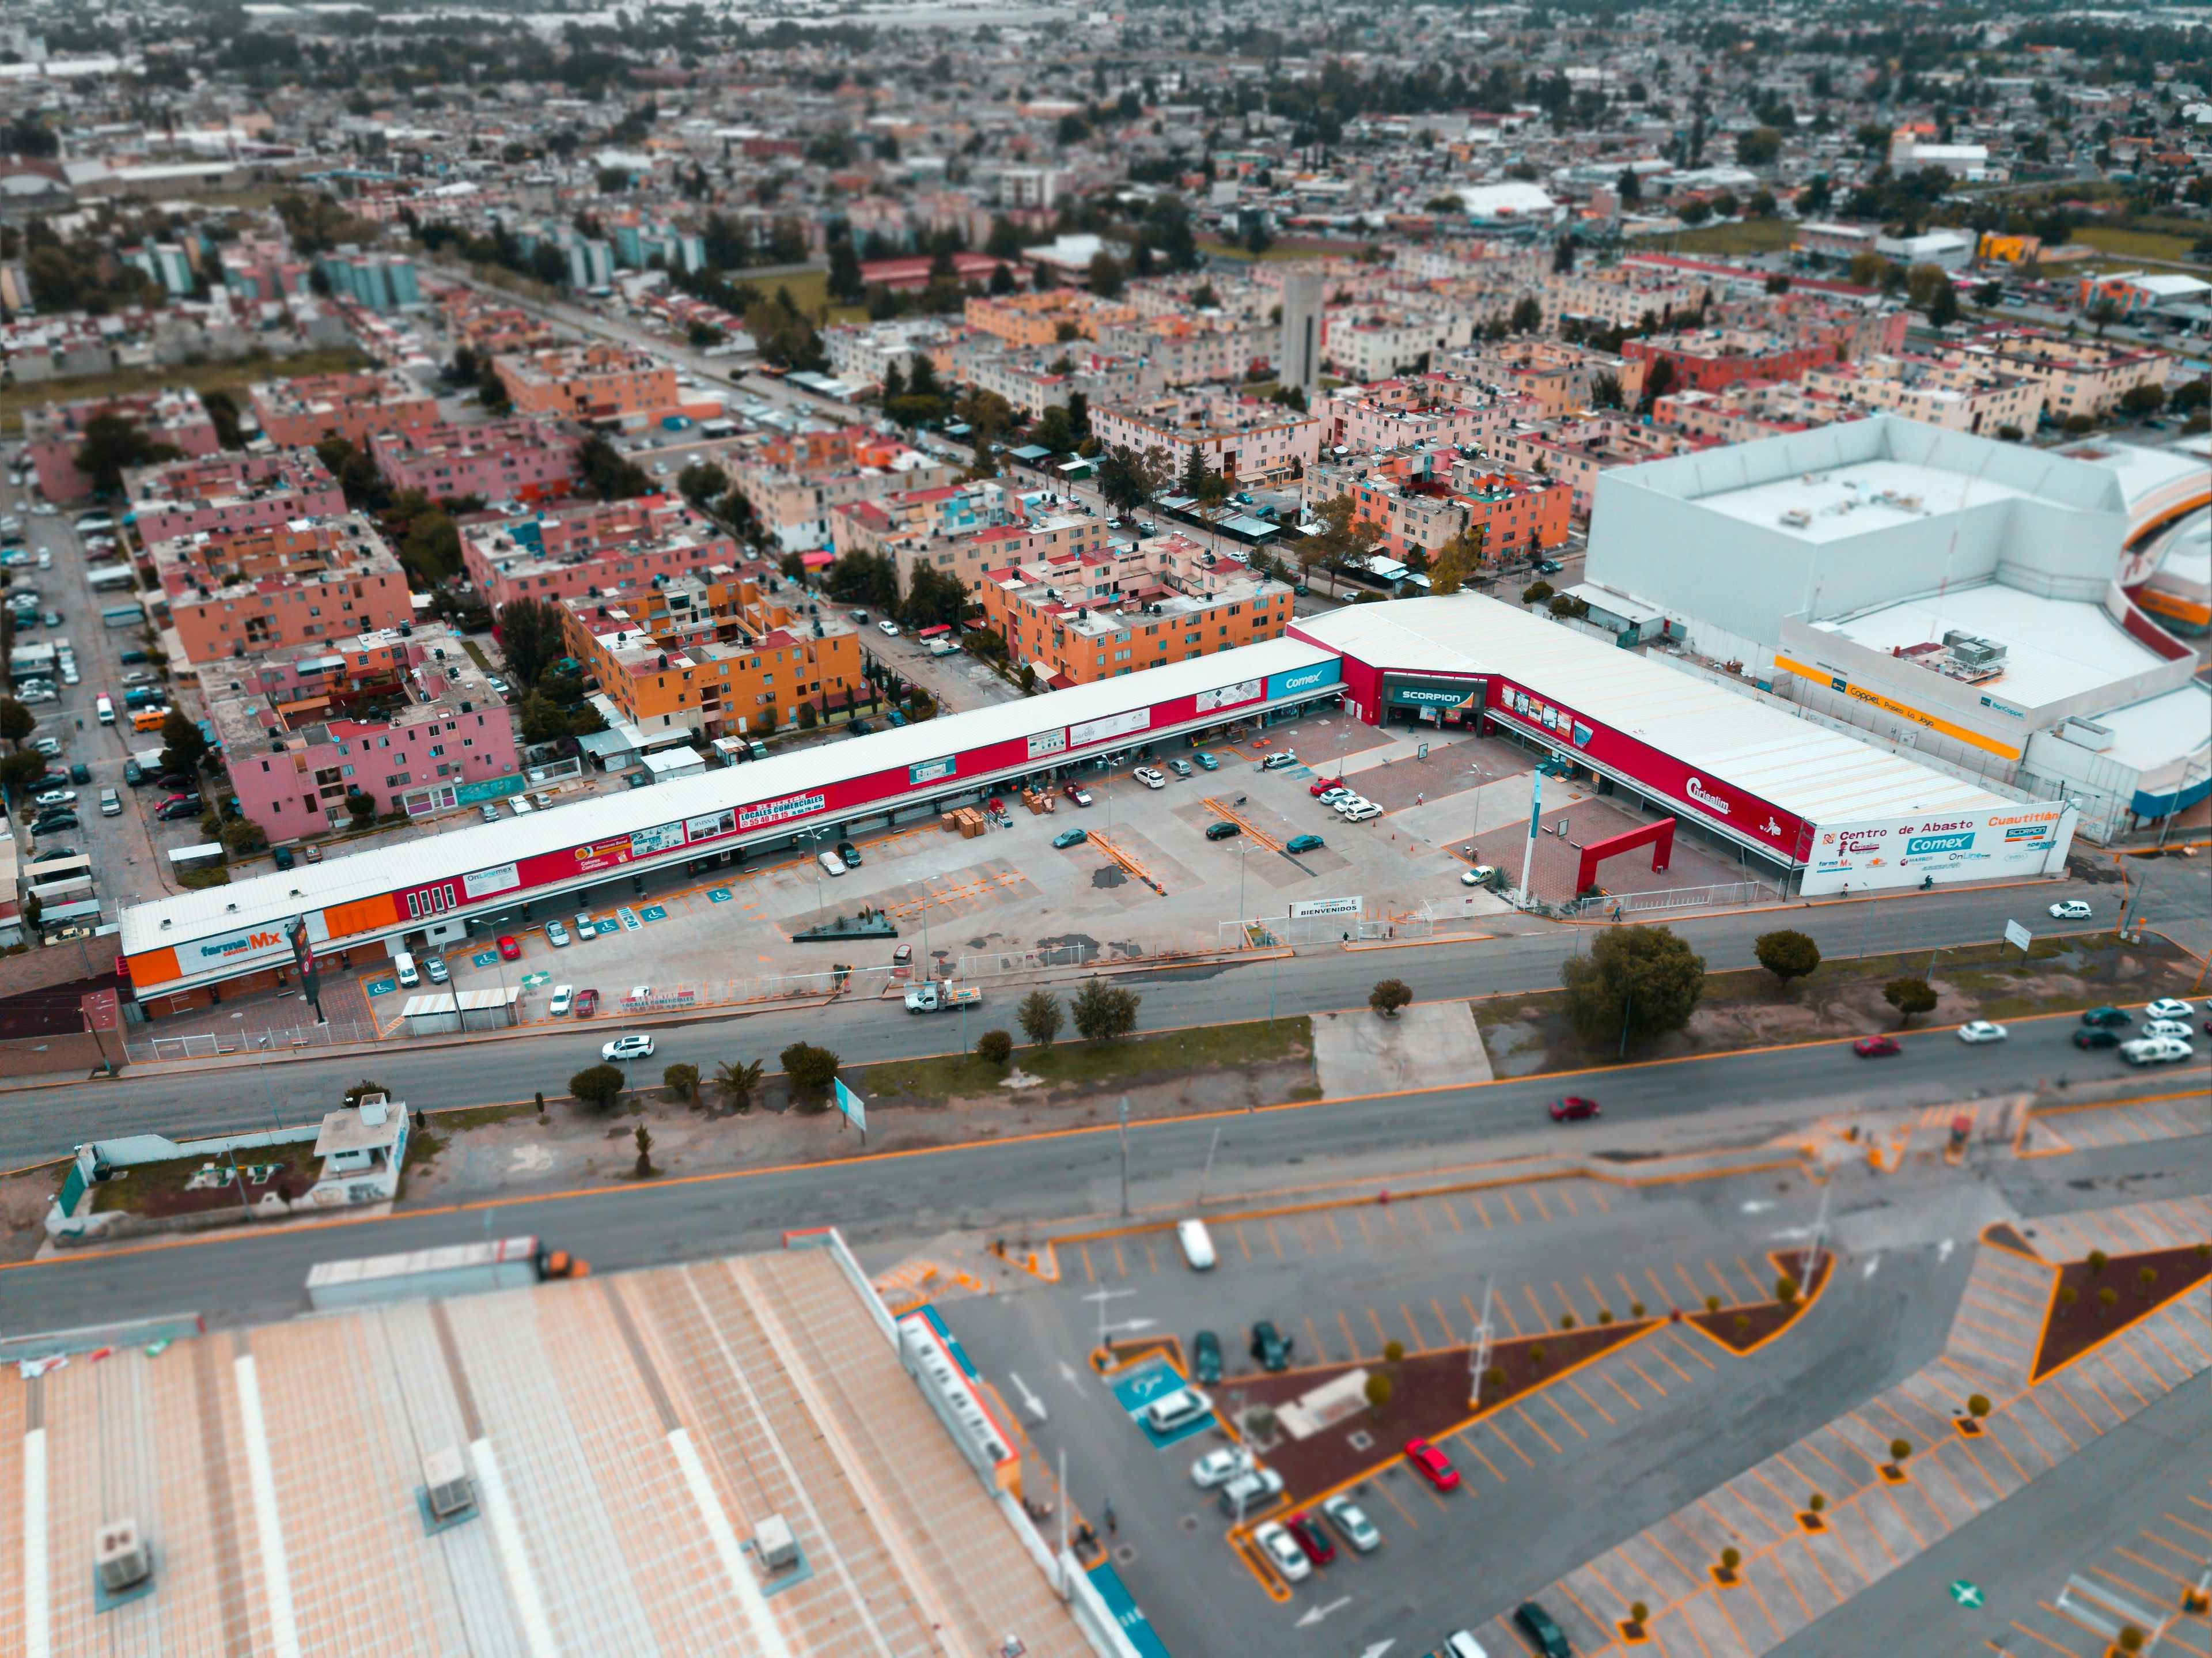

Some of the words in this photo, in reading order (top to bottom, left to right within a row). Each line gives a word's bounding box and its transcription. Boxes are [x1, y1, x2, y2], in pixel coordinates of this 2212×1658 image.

[1286, 669, 1323, 689] Comex
[1402, 691, 1461, 702] SCORPION
[1850, 687, 1880, 705] Coppel
[1686, 777, 1729, 815] Chrisalim
[741, 808, 772, 821] LOCALES
[774, 796, 823, 813] COMERCIALES
[760, 815, 770, 823] 40
[771, 813, 779, 821] 78
[781, 811, 789, 819] 15
[1988, 811, 2059, 827] Cuautitlán
[1840, 830, 1888, 841] Centro
[1899, 826, 1914, 835] de
[1921, 820, 1974, 833] Abasto
[1910, 834, 1972, 852] Comex
[467, 866, 512, 881] OnLinemex
[1301, 905, 1357, 915] BIENVENIDOS
[201, 939, 247, 957] farma
[248, 931, 283, 951] Mx
